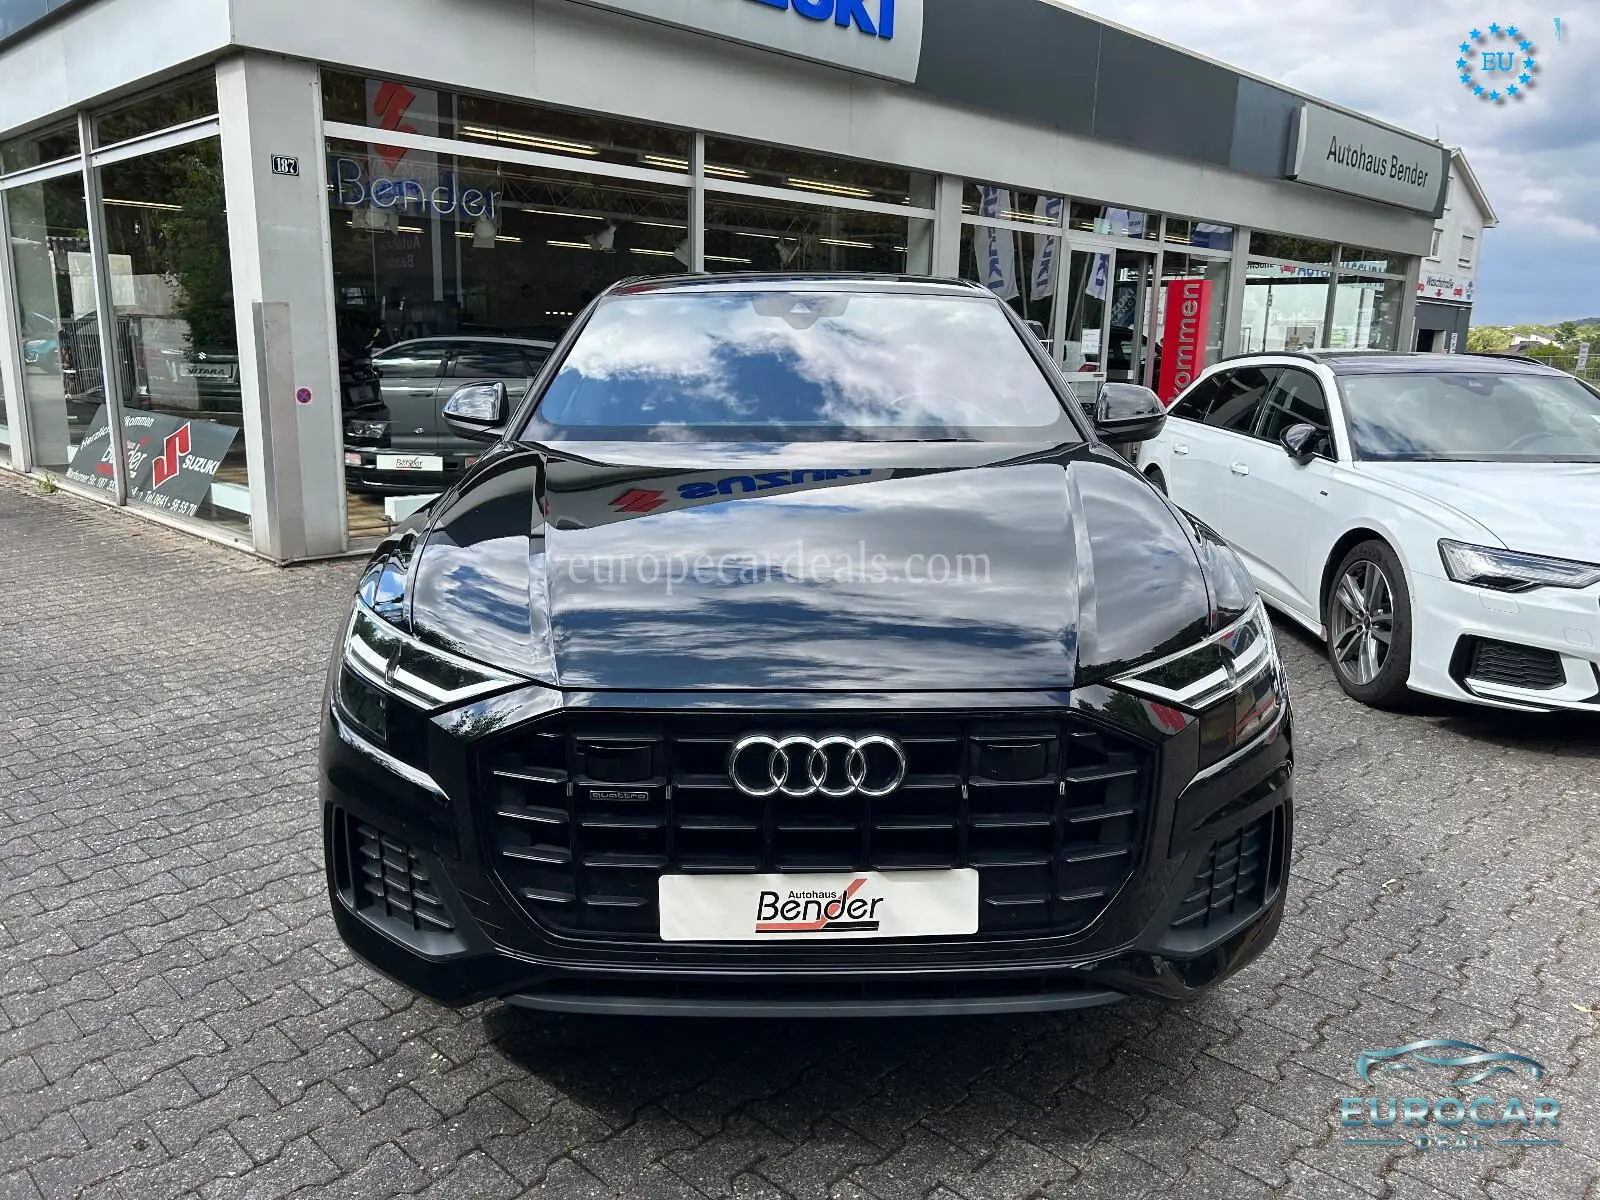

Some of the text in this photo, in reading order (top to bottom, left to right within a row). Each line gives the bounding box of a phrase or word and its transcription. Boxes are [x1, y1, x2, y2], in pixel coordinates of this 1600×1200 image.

[276, 158, 295, 173] 187
[1326, 136, 1429, 187] Autohaus Bender
[336, 158, 503, 219] Bender
[182, 454, 220, 475] SUZUKI
[592, 792, 646, 800] quattro
[788, 890, 837, 899] Autohaus
[756, 890, 883, 921] Bender
